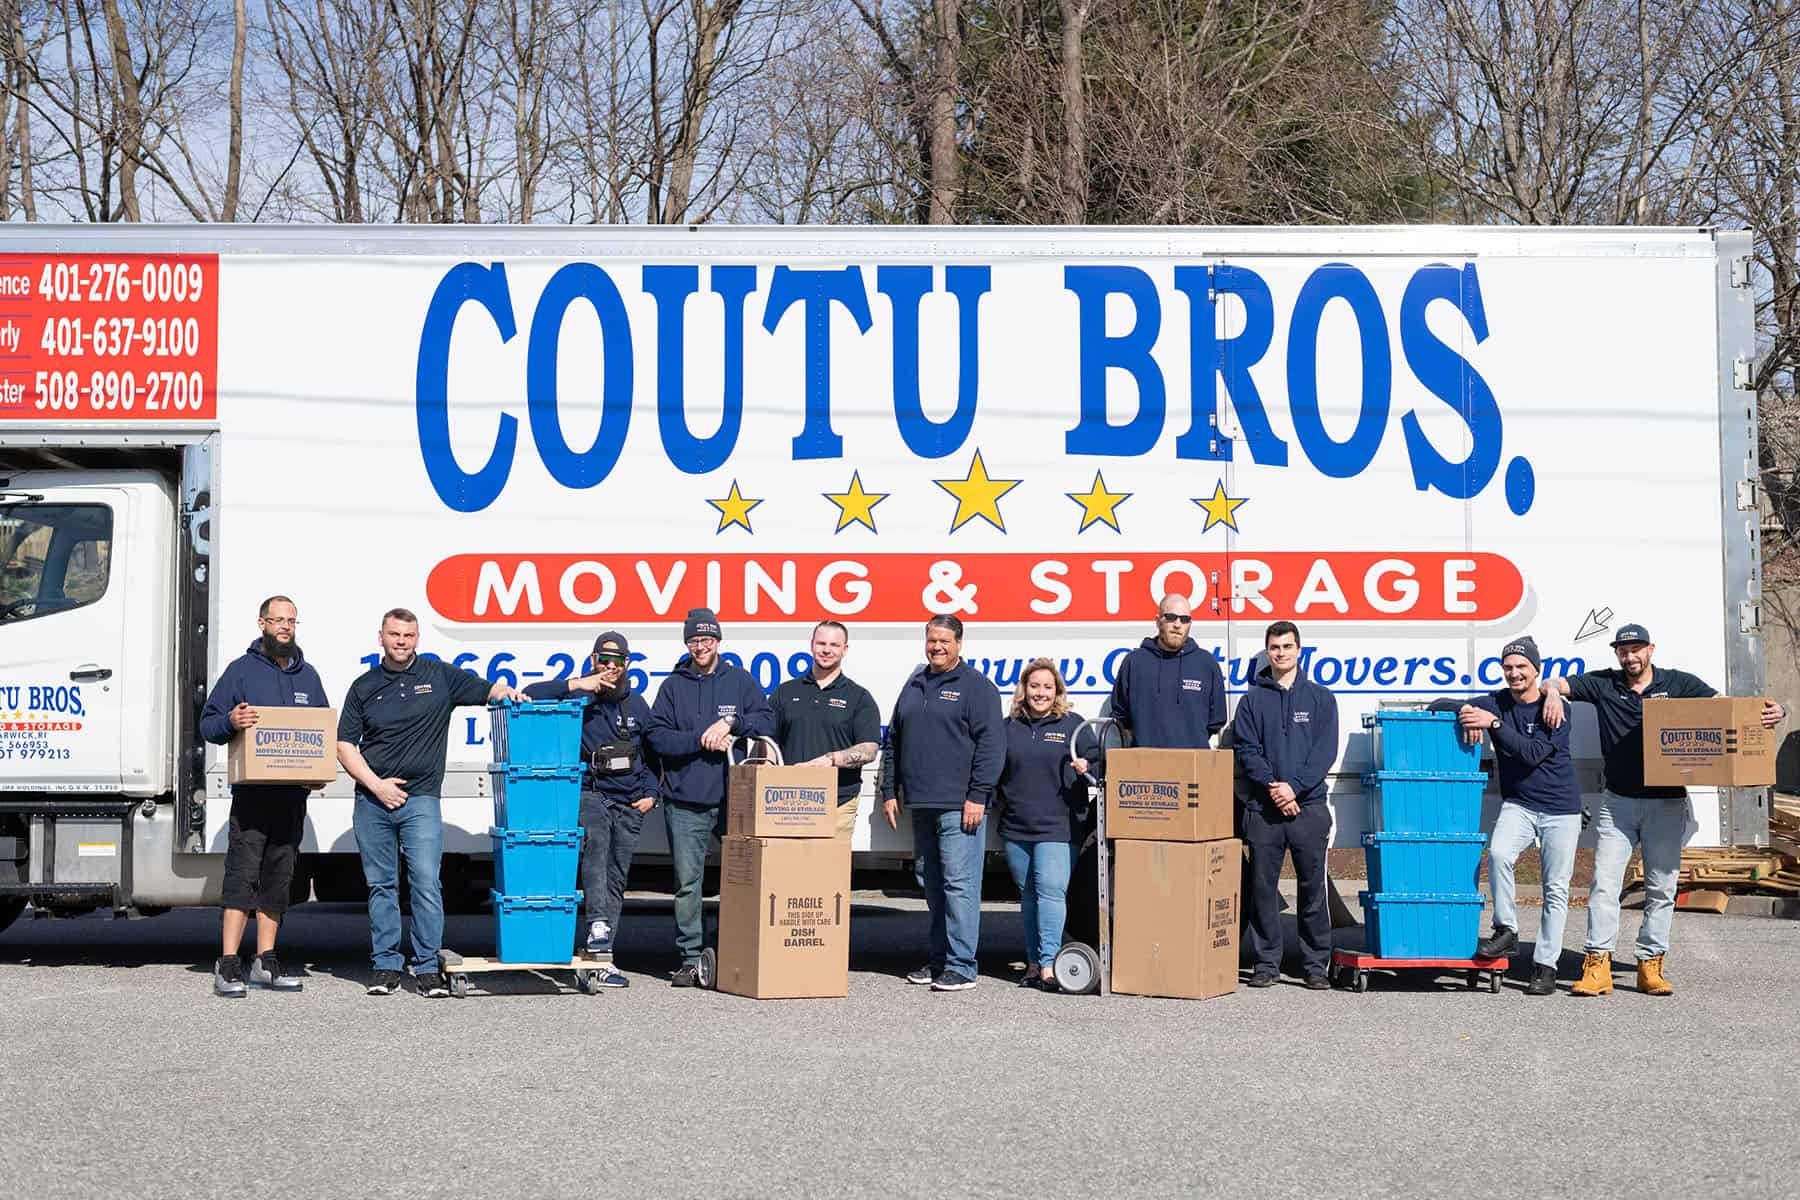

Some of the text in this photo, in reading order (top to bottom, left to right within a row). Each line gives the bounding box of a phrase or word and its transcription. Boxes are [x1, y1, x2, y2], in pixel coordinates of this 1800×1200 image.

[0, 263, 204, 302] nce 401-276-0009
[41, 317, 200, 356] 401-637-9100
[35, 371, 204, 410] 508-890-2700
[416, 262, 1535, 516] COUTU BROS.
[472, 558, 1478, 616] MOVING & STORAGE
[28, 685, 86, 717] BROS.
[9, 741, 48, 749] 566953
[255, 731, 323, 747] COUTU BROS
[1660, 731, 1721, 746] COUTU BROS
[20, 748, 71, 760] 979213
[764, 789, 825, 804] COUTU BROS
[1119, 783, 1178, 799] COUTU BROS
[787, 897, 823, 909] FRAGILE
[791, 928, 816, 937] DISH
[783, 938, 825, 947] BARREL
